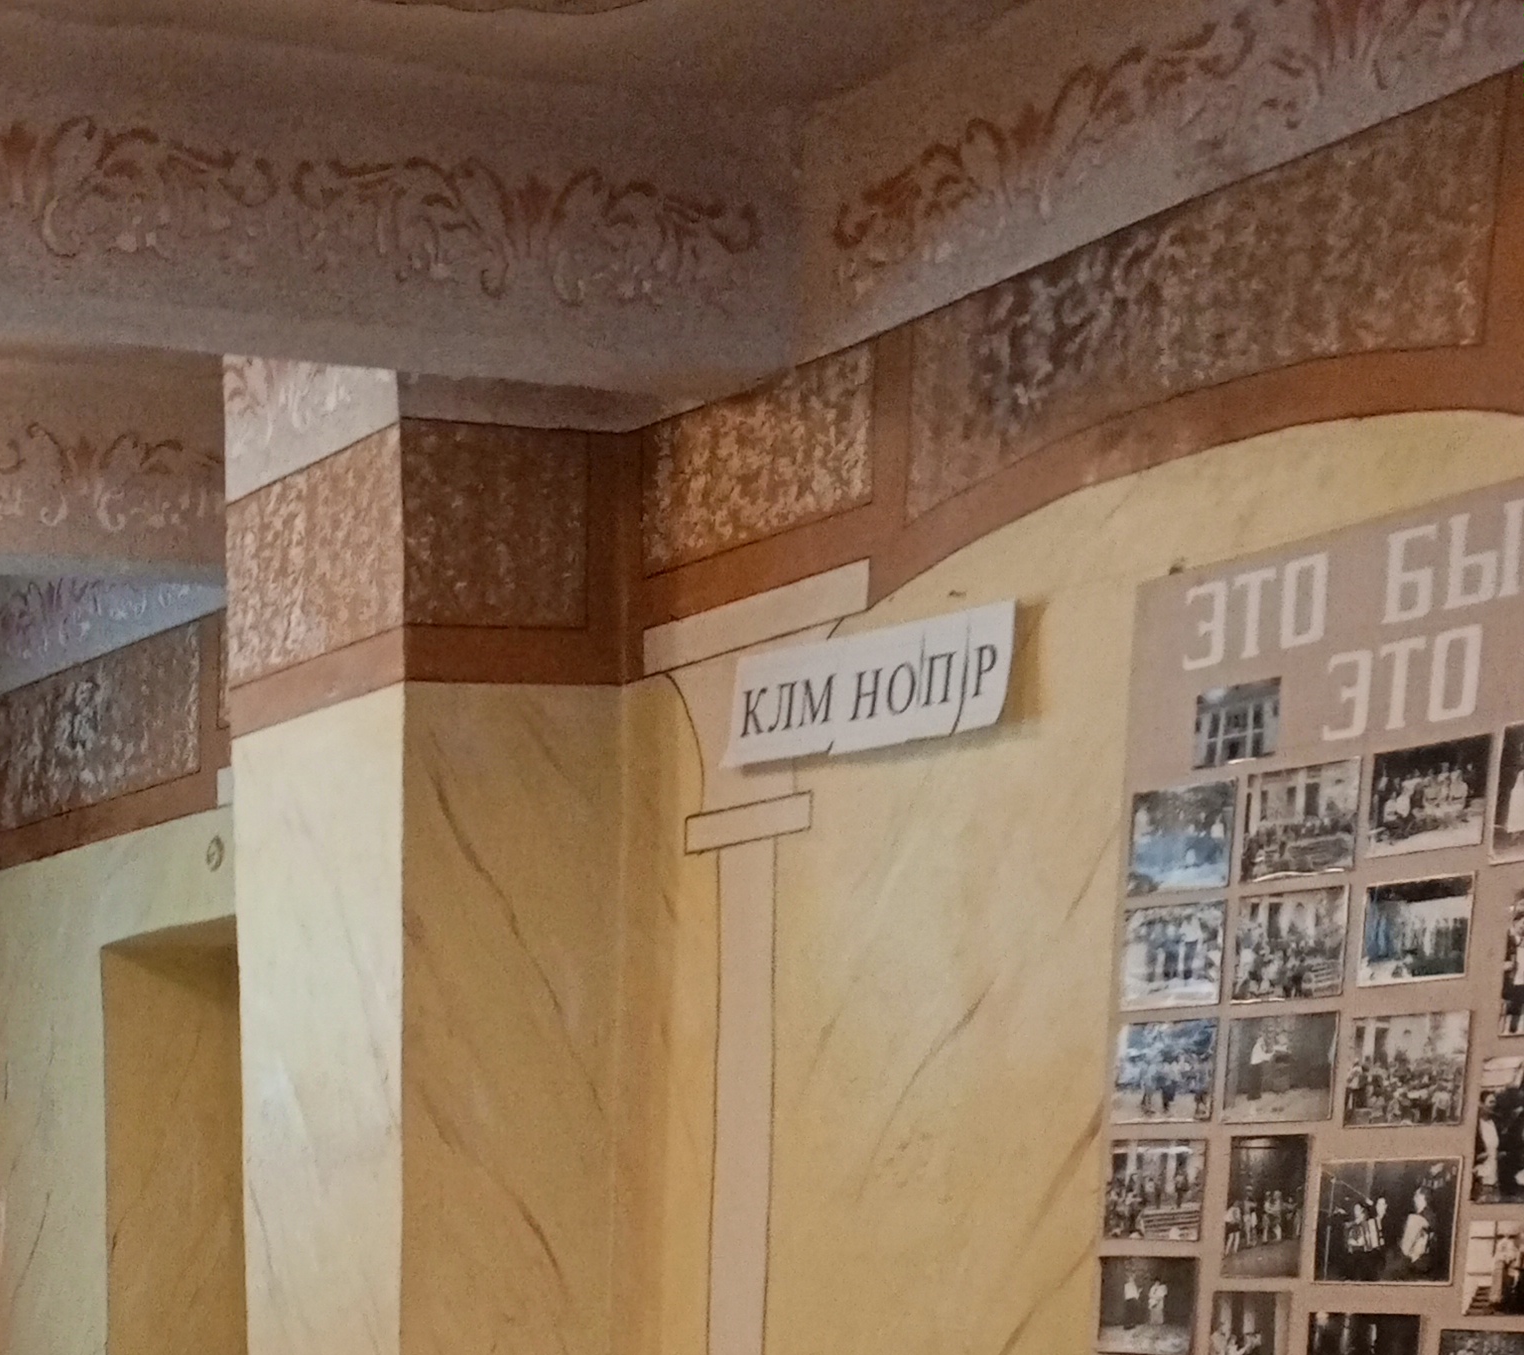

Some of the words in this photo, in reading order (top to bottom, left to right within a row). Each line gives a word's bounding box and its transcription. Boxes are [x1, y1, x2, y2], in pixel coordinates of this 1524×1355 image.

[1182, 552, 1328, 672] ЭТО
[739, 673, 838, 738] КЛМ
[1323, 623, 1483, 741] ЭТО
